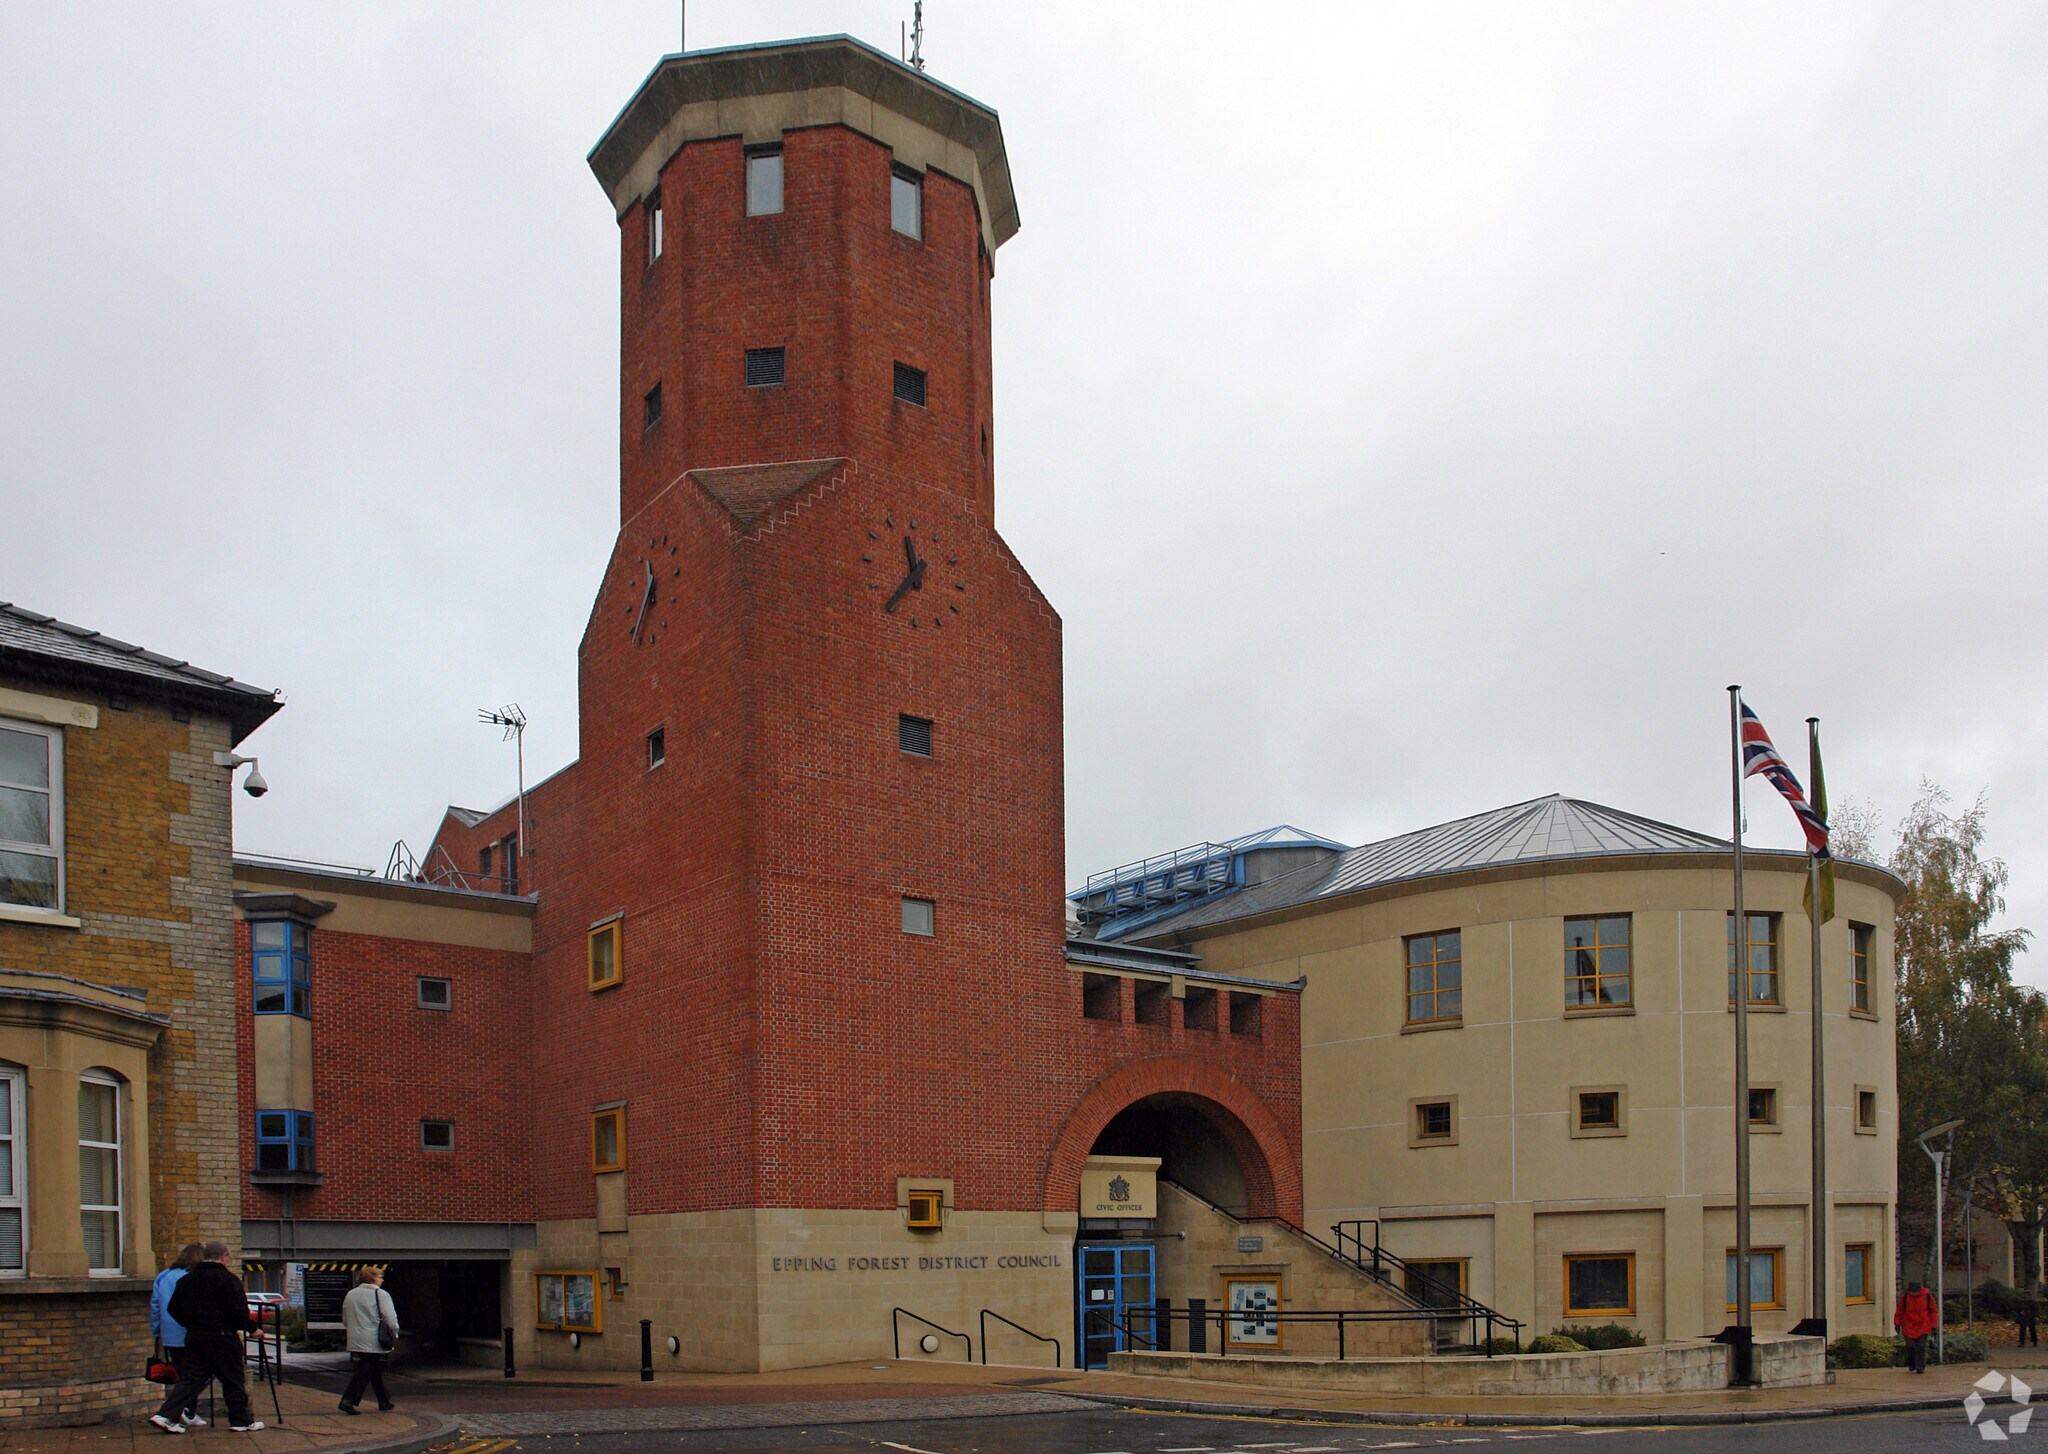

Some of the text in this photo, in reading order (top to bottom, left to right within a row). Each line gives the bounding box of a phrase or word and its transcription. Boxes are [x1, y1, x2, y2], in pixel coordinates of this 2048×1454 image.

[772, 1255, 1061, 1271] EPPING FOREST DISTRICT COUNCIL
